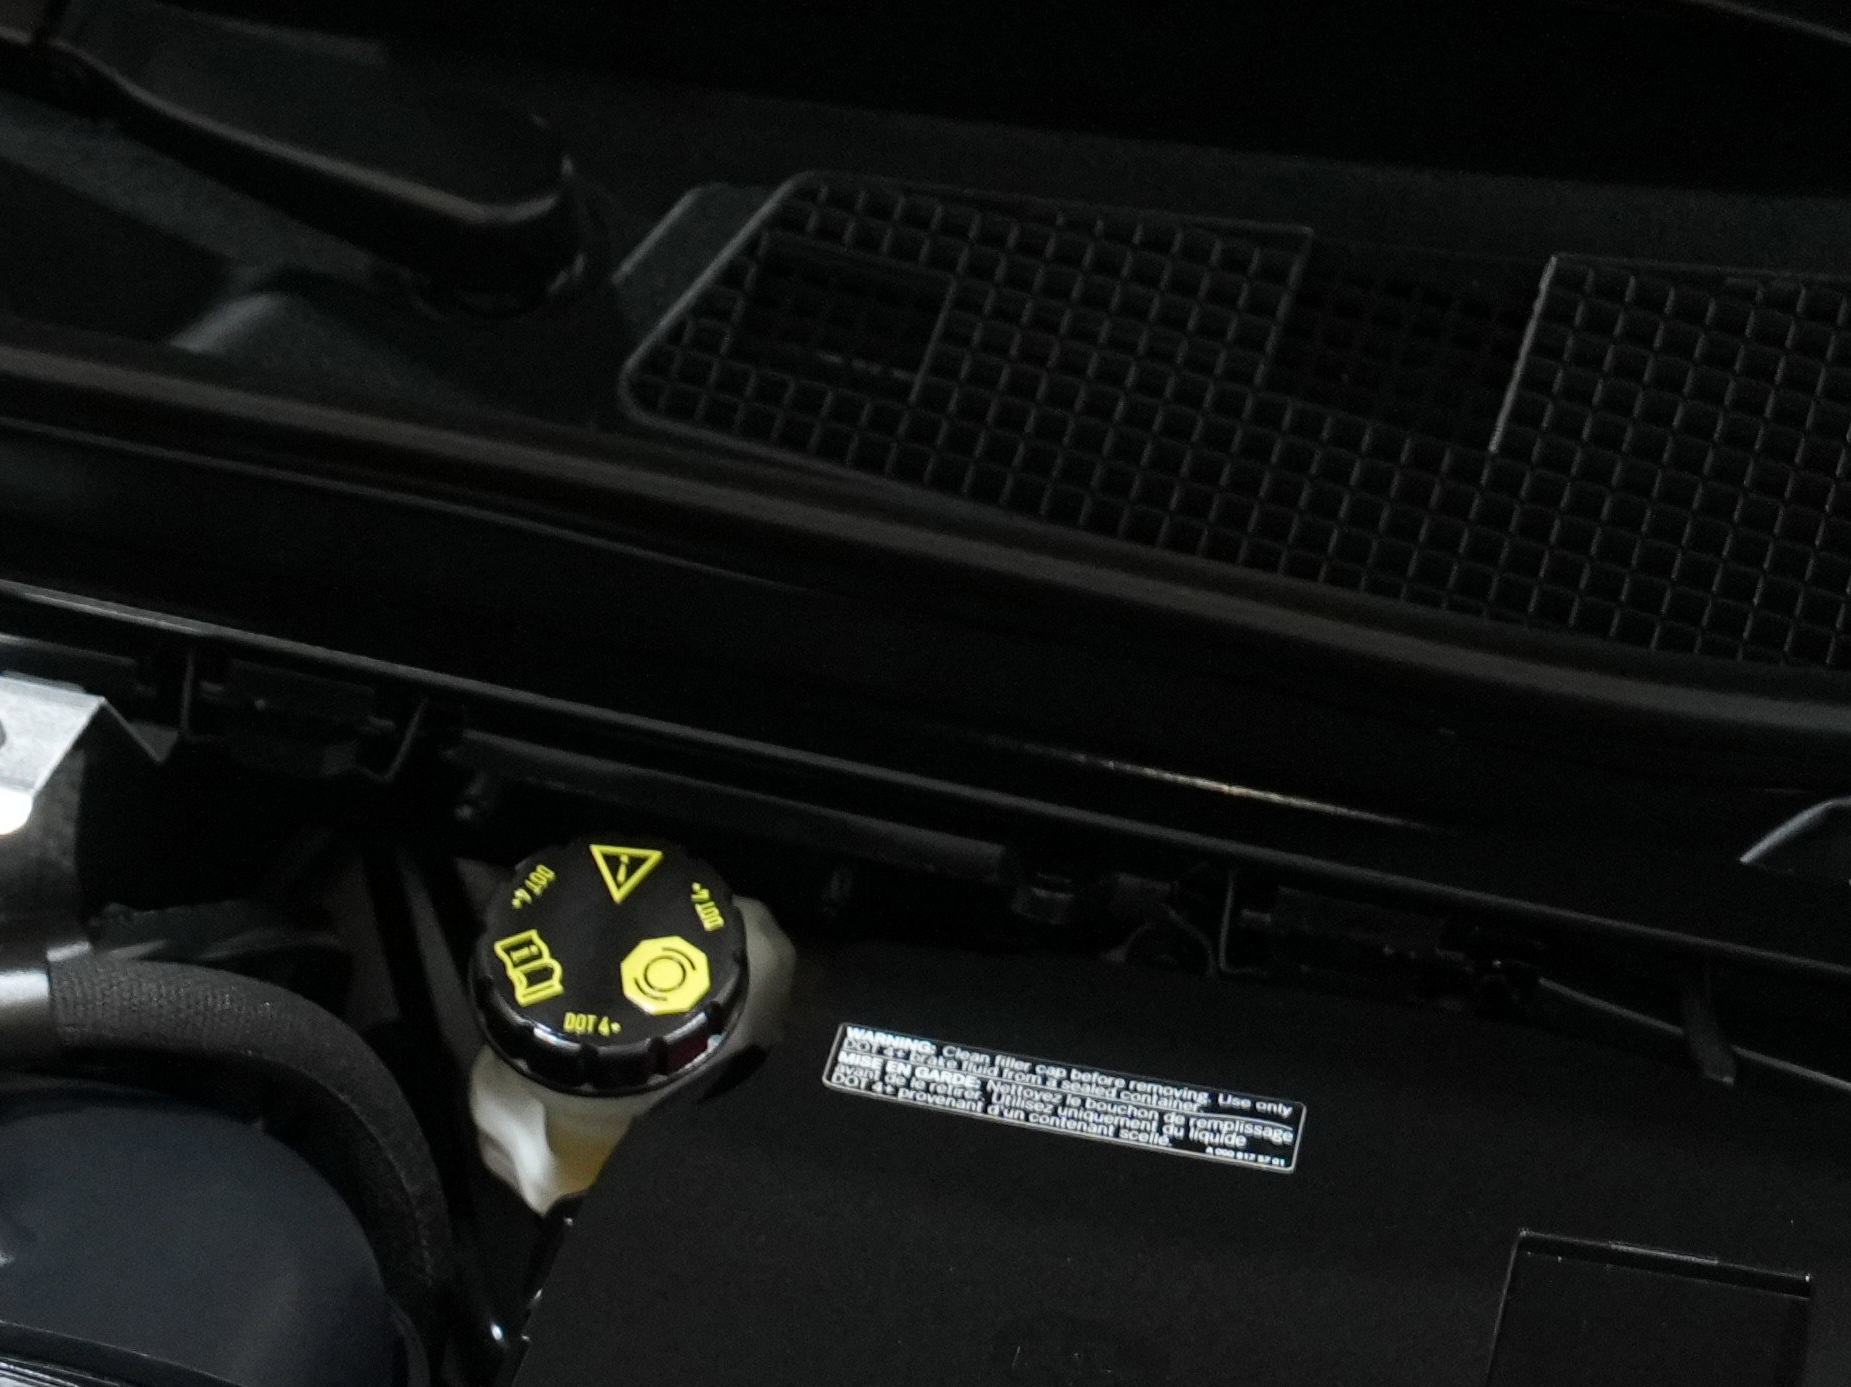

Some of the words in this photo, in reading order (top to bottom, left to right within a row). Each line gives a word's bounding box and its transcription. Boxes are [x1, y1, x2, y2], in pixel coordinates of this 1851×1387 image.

[524, 863, 556, 897] DOT
[694, 900, 726, 932] DOT
[563, 1011, 598, 1035] DOT
[838, 1051, 884, 1070] MISE
[885, 1060, 912, 1078] EN
[915, 1066, 982, 1090] GARDE:
[986, 1080, 1063, 1104] Nettoyez
[1065, 1093, 1082, 1107] le
[1085, 1097, 1159, 1121] bouchon
[1163, 1112, 1186, 1126] de
[1189, 1117, 1294, 1146] remplissage
[842, 1037, 879, 1054] DOT
[910, 1050, 958, 1070] brake
[961, 1060, 1000, 1078] fluid
[1002, 1067, 1043, 1085] from
[1045, 1078, 1058, 1089] a
[1061, 1080, 1117, 1099] sealed
[846, 1026, 937, 1055] WARNING:
[942, 1045, 991, 1067] Clean
[995, 1054, 1032, 1073] filler
[1035, 1064, 1067, 1080] cap
[1071, 1067, 1126, 1089] before
[1129, 1080, 1212, 1107] removing.
[1217, 1092, 1252, 1110] Use
[1255, 1100, 1293, 1119] only
[831, 1072, 869, 1090] DOT
[897, 1087, 985, 1113] provenant
[987, 1103, 1026, 1121] d'un
[1029, 1112, 1115, 1137] contenant
[834, 1062, 881, 1082] avant
[884, 1073, 907, 1087] de
[910, 1076, 927, 1091] le
[991, 1092, 1054, 1114] Utilisez
[1057, 1105, 1158, 1133] uniquement
[1162, 1123, 1185, 1140] du
[1189, 1127, 1247, 1149] liquide
